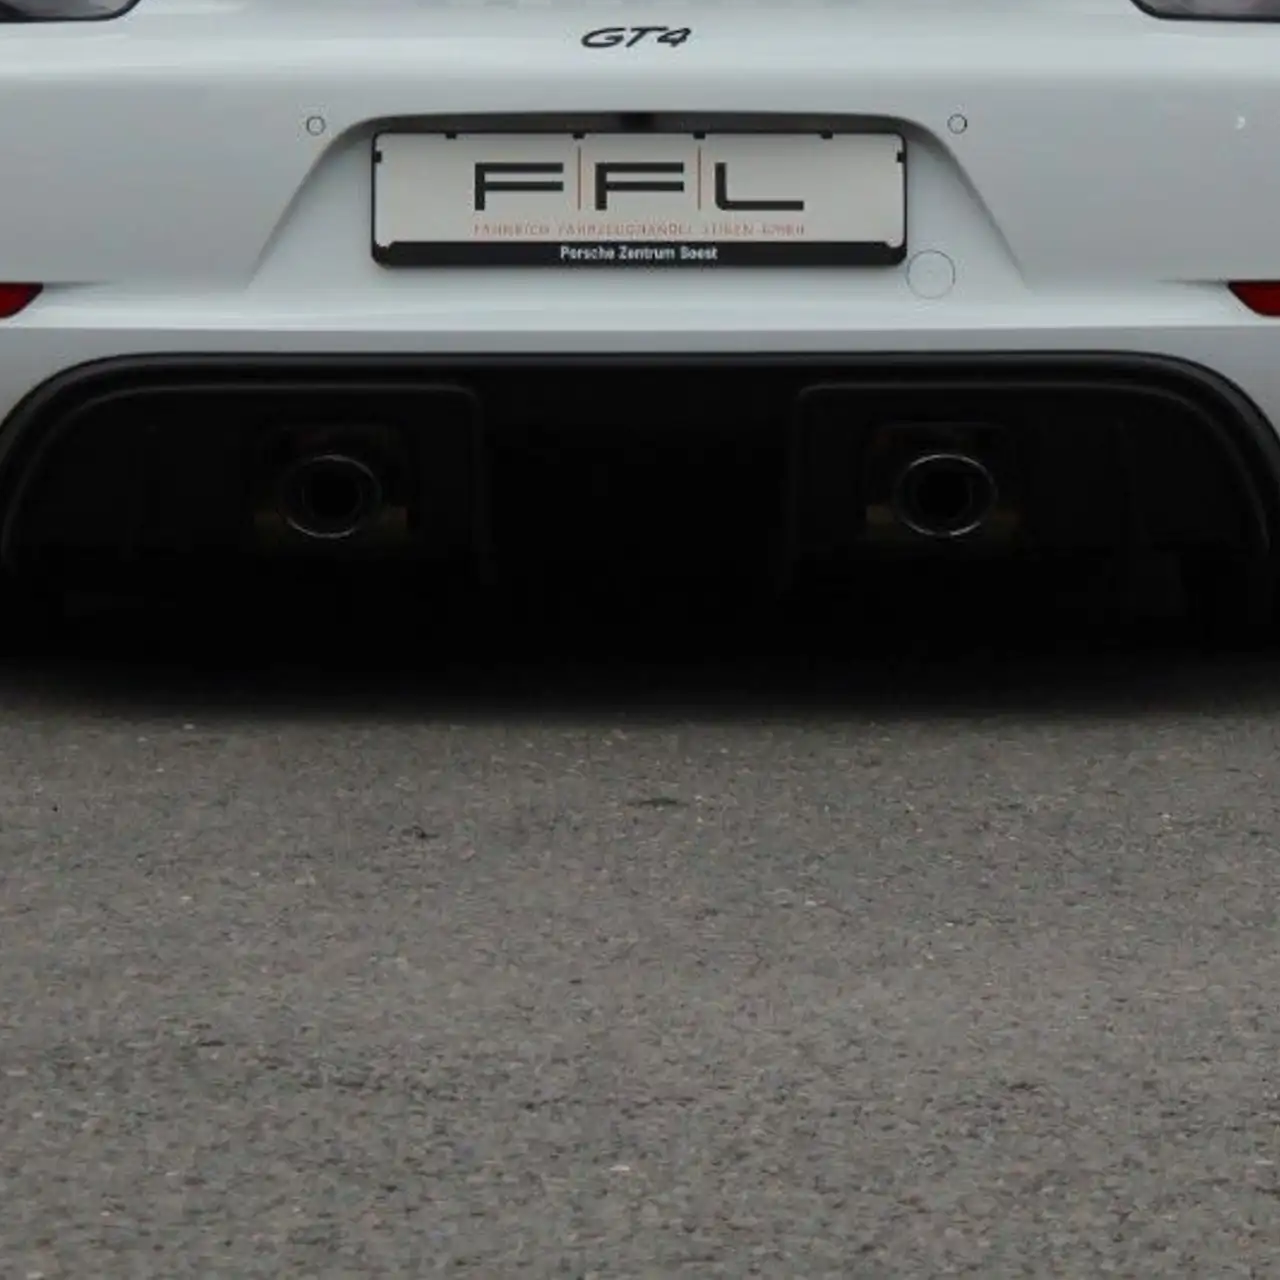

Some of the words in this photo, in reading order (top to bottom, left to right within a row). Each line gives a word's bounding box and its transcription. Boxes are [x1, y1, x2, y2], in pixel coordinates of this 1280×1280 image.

[580, 26, 692, 48] GT4
[559, 245, 615, 259] Porsche
[617, 245, 676, 259] Zentrum
